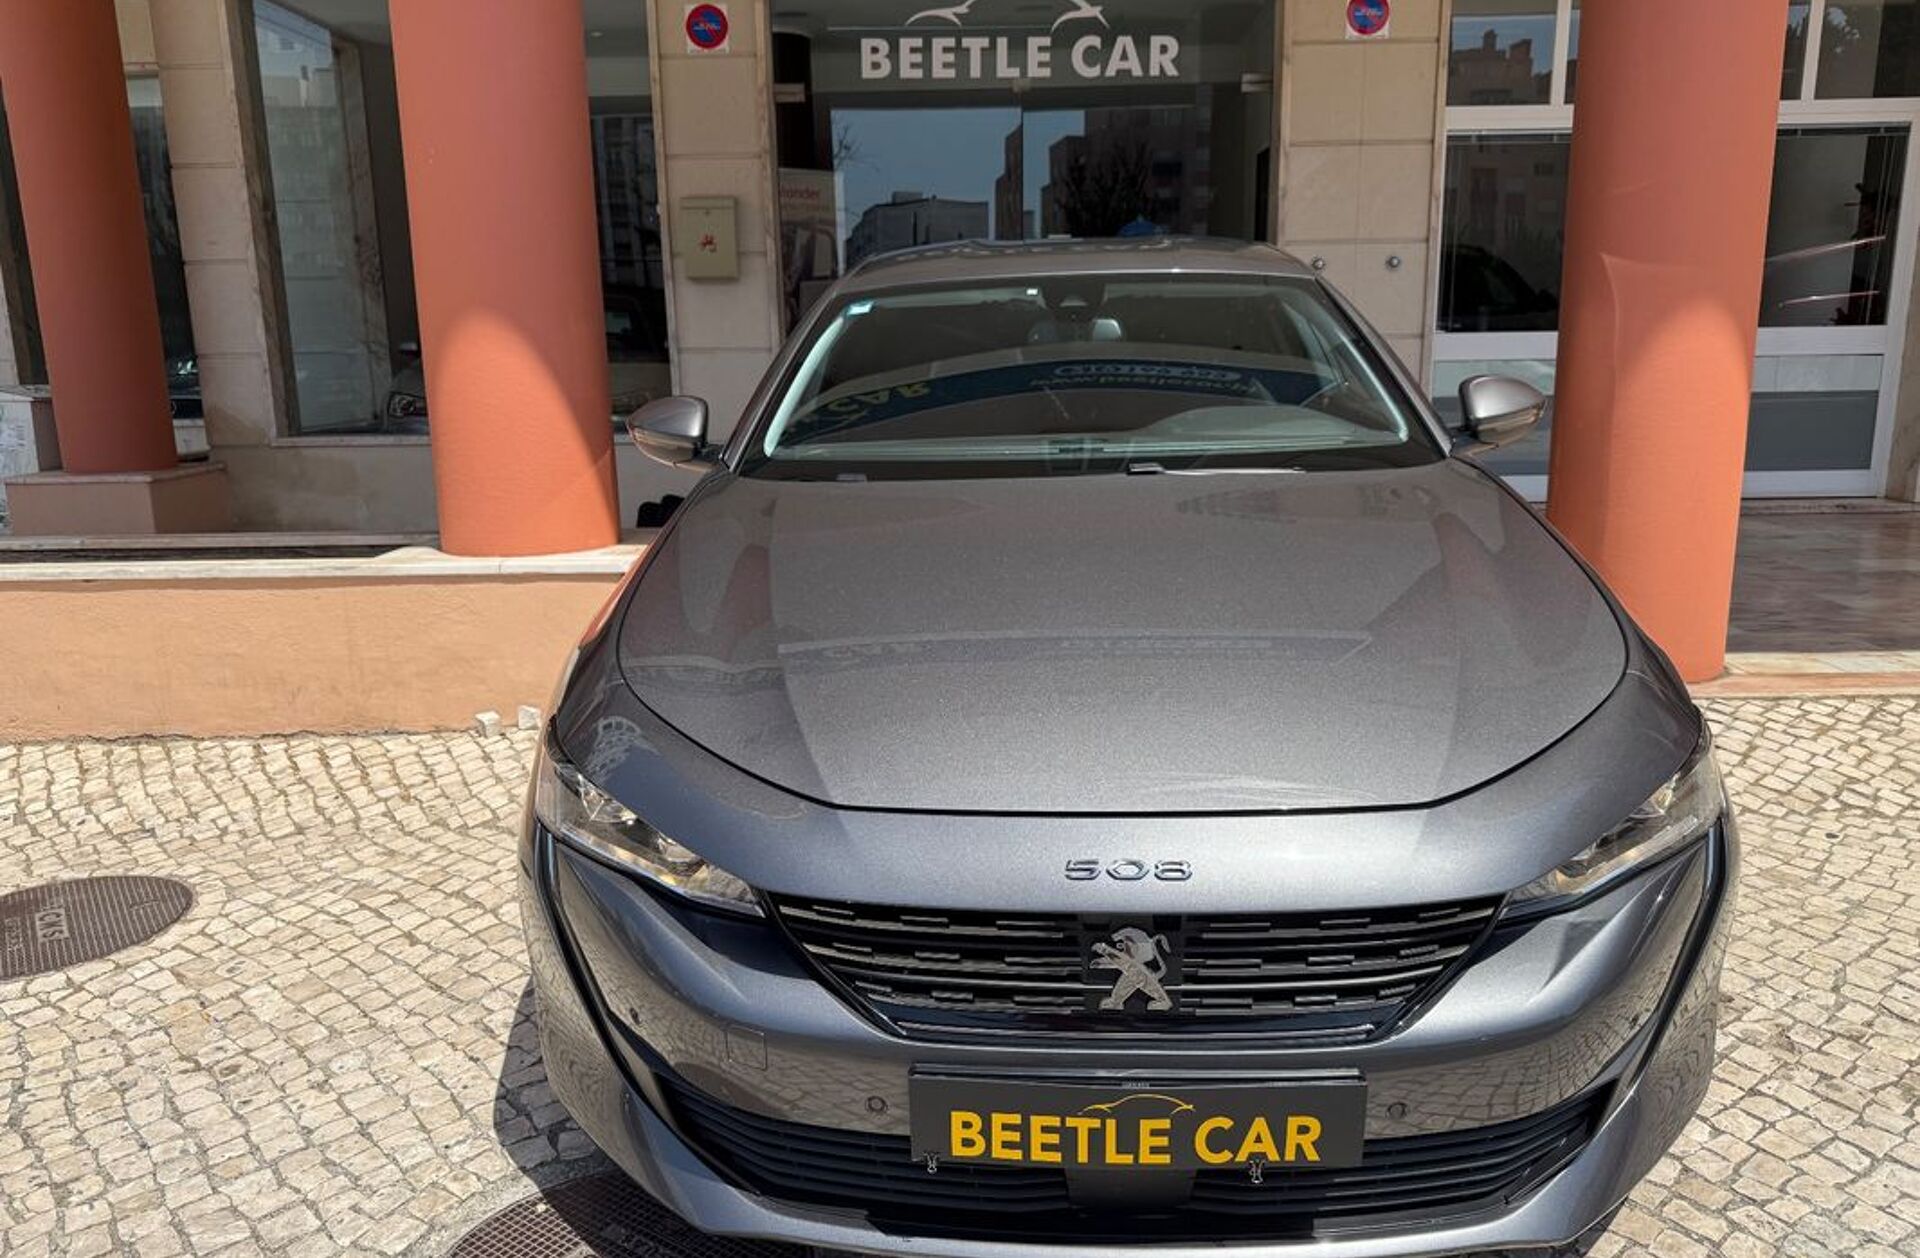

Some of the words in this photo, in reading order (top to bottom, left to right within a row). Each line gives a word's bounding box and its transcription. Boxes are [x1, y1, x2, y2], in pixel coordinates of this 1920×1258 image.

[860, 36, 1051, 79] BEETLE
[1071, 35, 1180, 78] CAR
[1064, 859, 1193, 881] 508
[950, 1110, 1172, 1165] BEETLE
[1194, 1115, 1322, 1163] CAR
